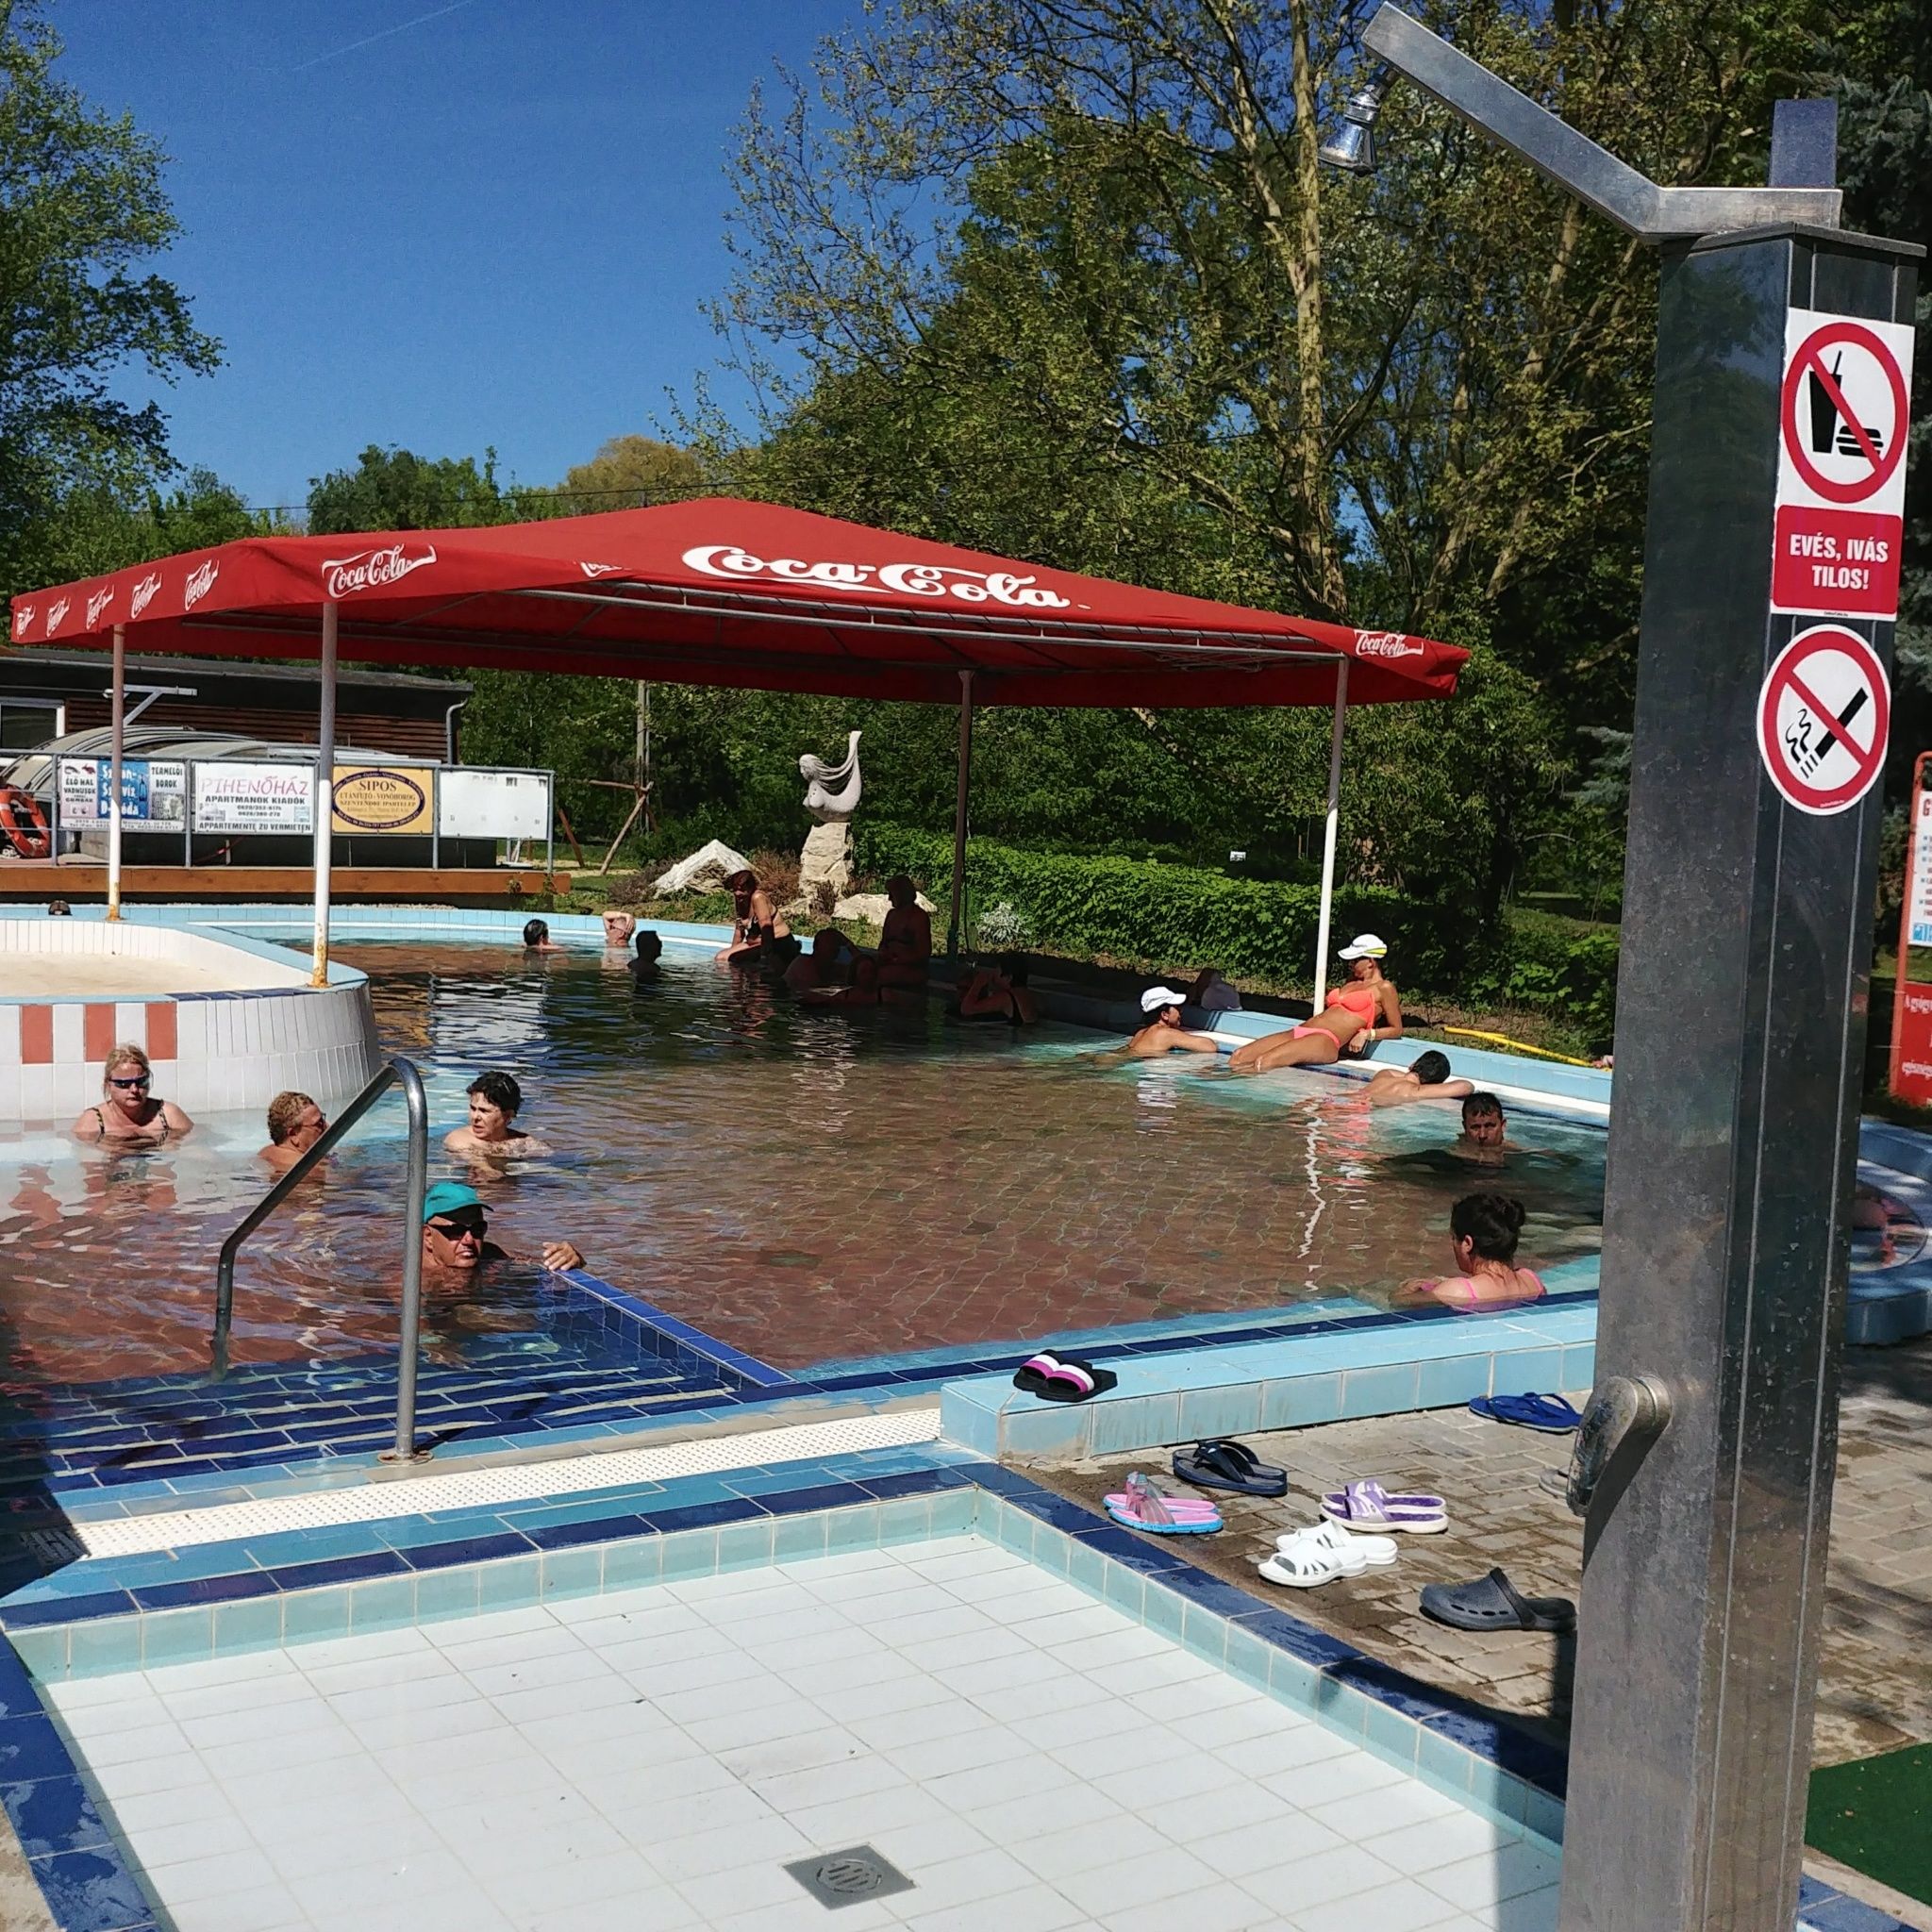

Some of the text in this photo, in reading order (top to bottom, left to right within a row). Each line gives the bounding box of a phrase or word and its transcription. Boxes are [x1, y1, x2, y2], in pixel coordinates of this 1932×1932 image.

[1790, 532, 1889, 563] EVÉS, IVÁS
[322, 543, 438, 598] Coca-Cola
[681, 544, 1071, 608] Coca-Cola
[1811, 565, 1870, 590] TILOS!
[1354, 629, 1424, 658] Coca-Cola
[201, 775, 308, 796] PIHENŐHÁZ
[358, 780, 397, 792] SIPOS
[205, 795, 306, 805] APARTMANOK KIADÓK
[199, 822, 256, 830] APPARTEMENTE
[270, 823, 311, 831] VERMIETEN
